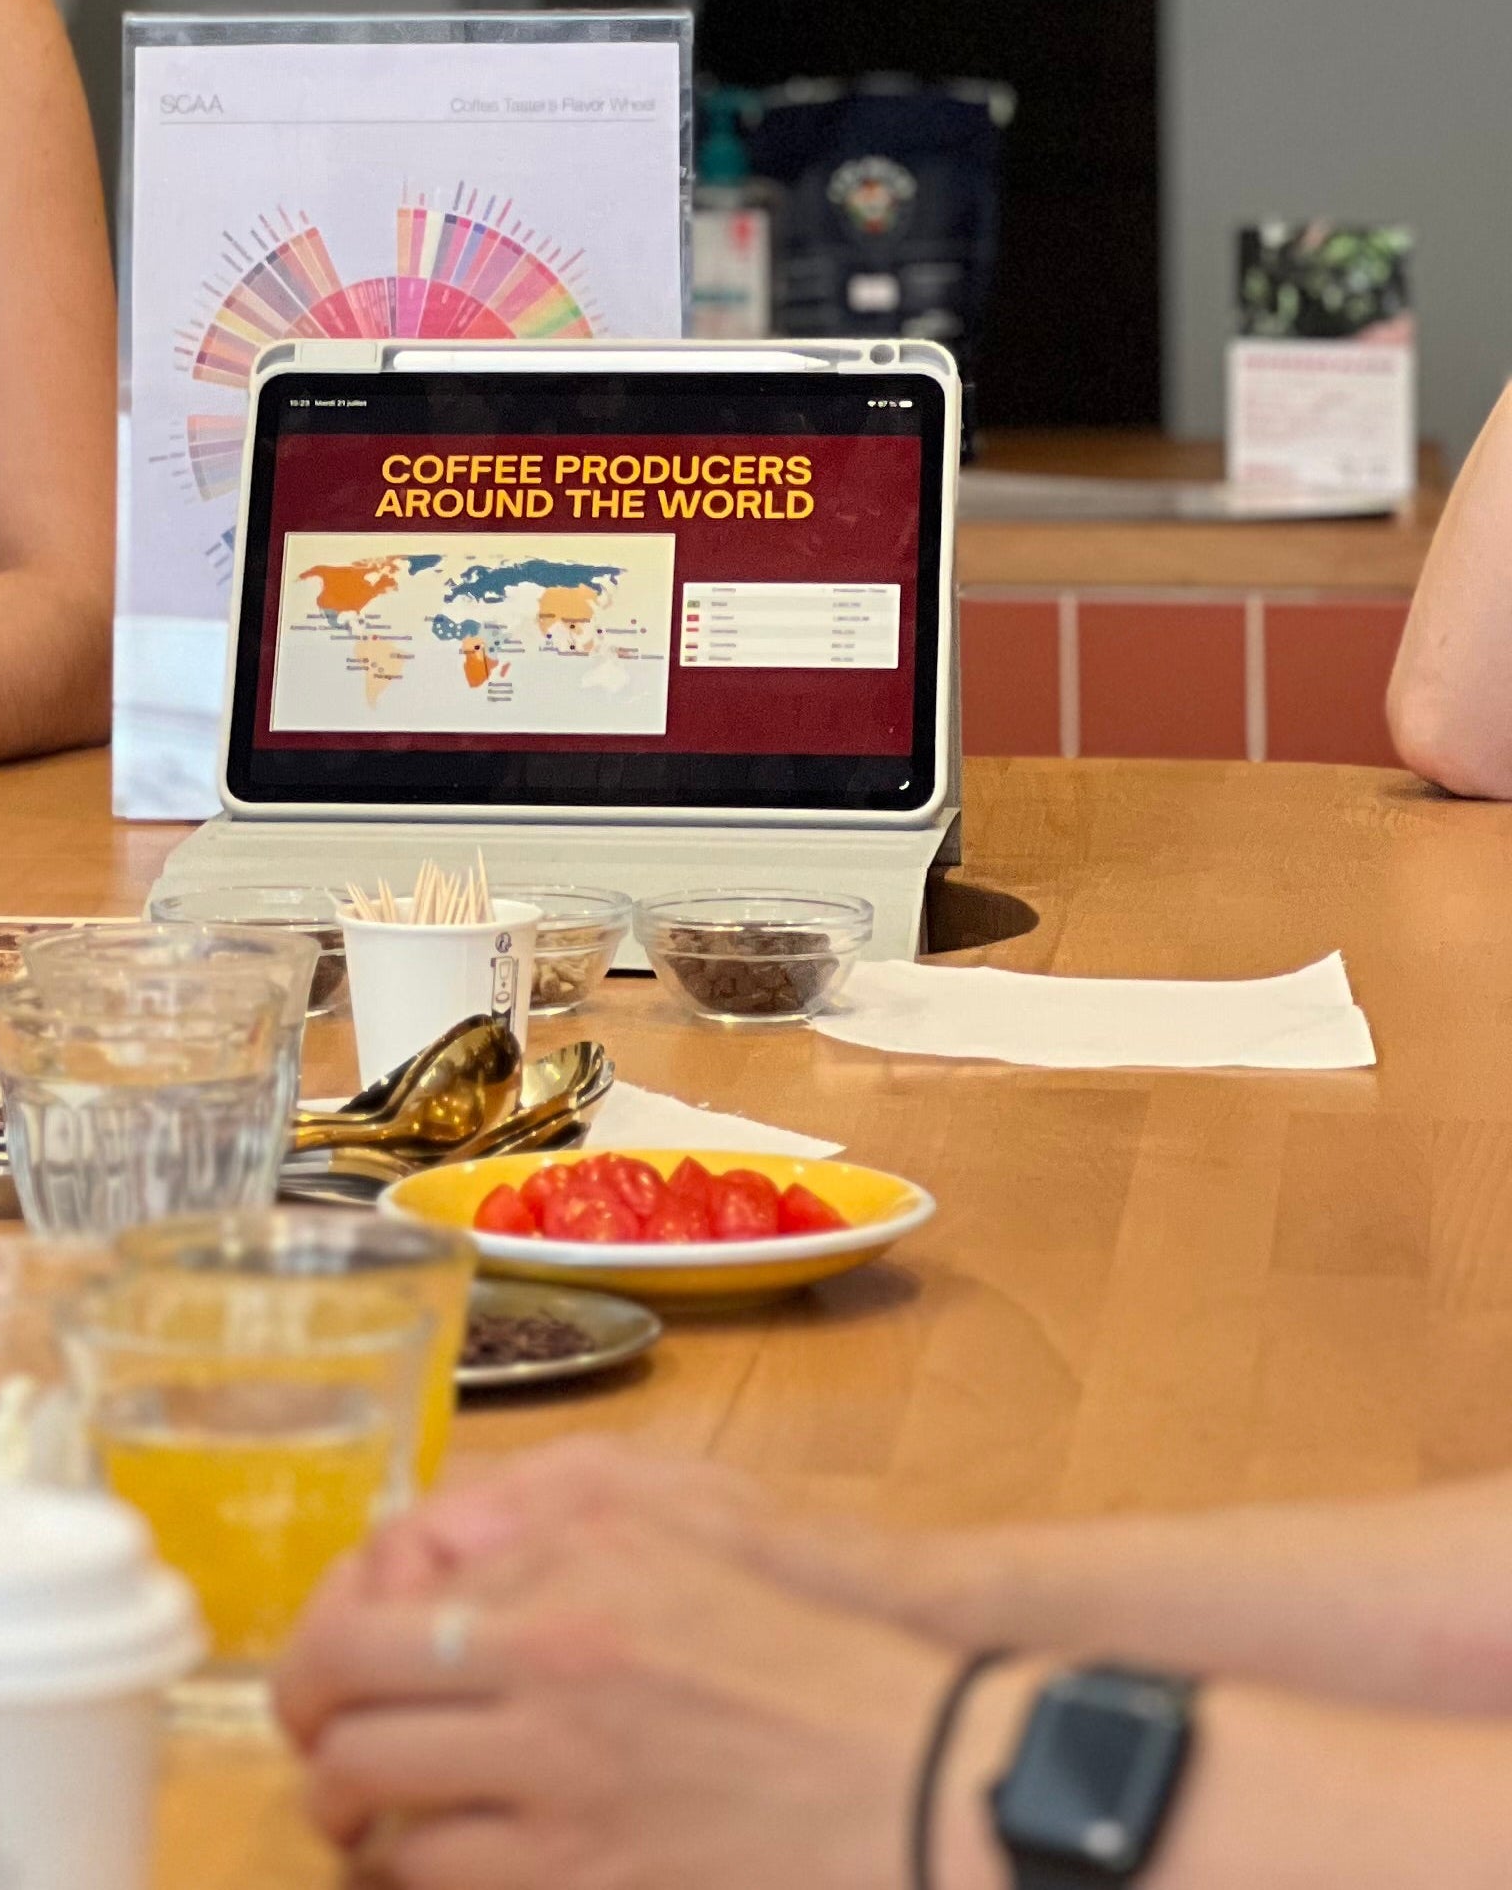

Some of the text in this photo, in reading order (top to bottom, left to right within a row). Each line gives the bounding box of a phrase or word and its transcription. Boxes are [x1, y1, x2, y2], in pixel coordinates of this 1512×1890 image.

[160, 94, 224, 115] SCAA
[381, 454, 812, 485] COFFEE PRODUCERS
[374, 488, 815, 519] AROUND THE WORLD
